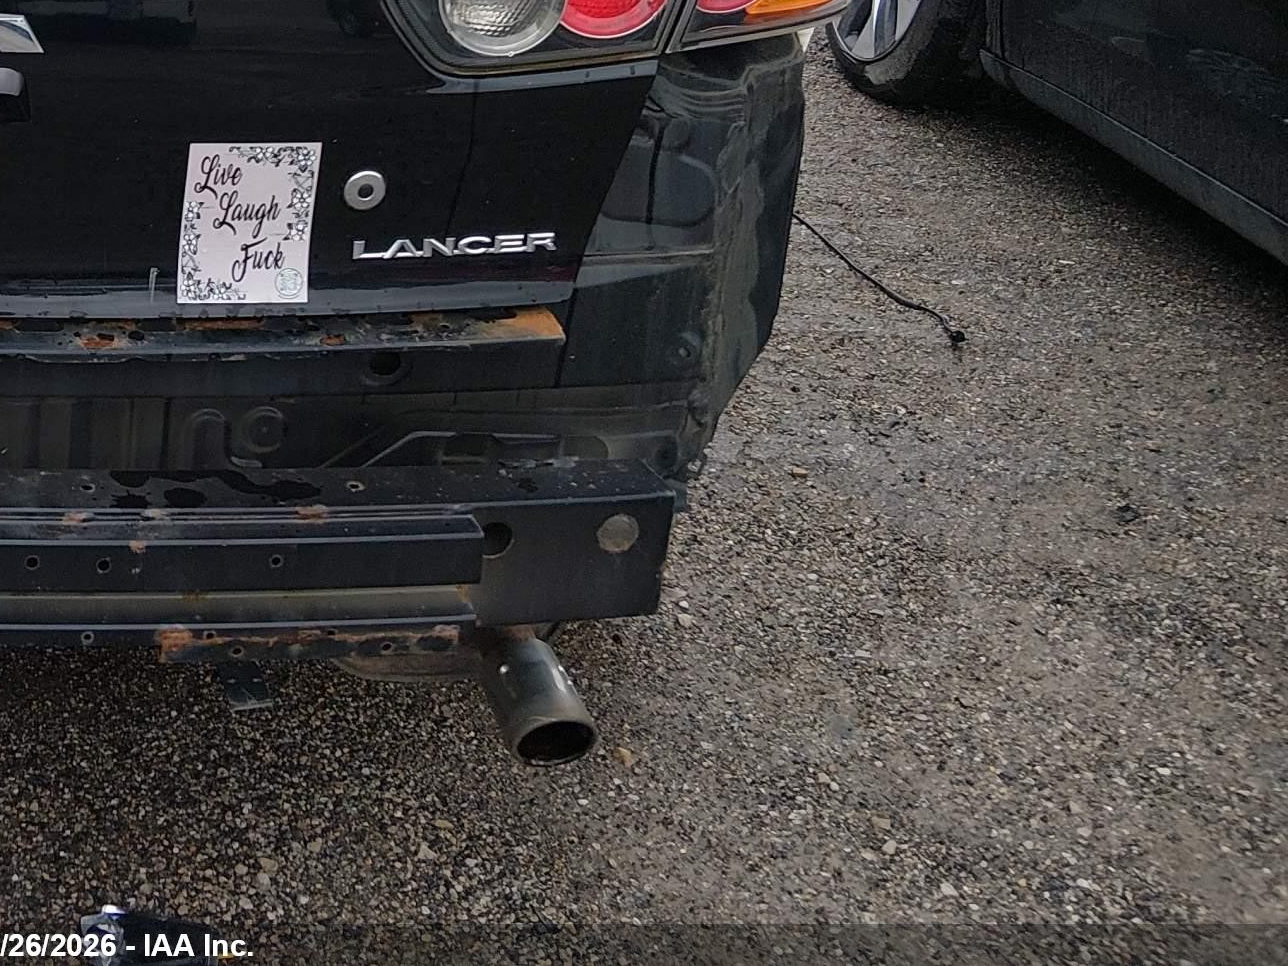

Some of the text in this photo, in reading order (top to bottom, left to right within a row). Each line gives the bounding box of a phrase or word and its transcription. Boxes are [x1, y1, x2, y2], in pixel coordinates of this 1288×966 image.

[194, 154, 243, 199] Live
[213, 190, 281, 239] Laugh
[231, 237, 286, 283] Fuck
[352, 232, 557, 260] LANCER
